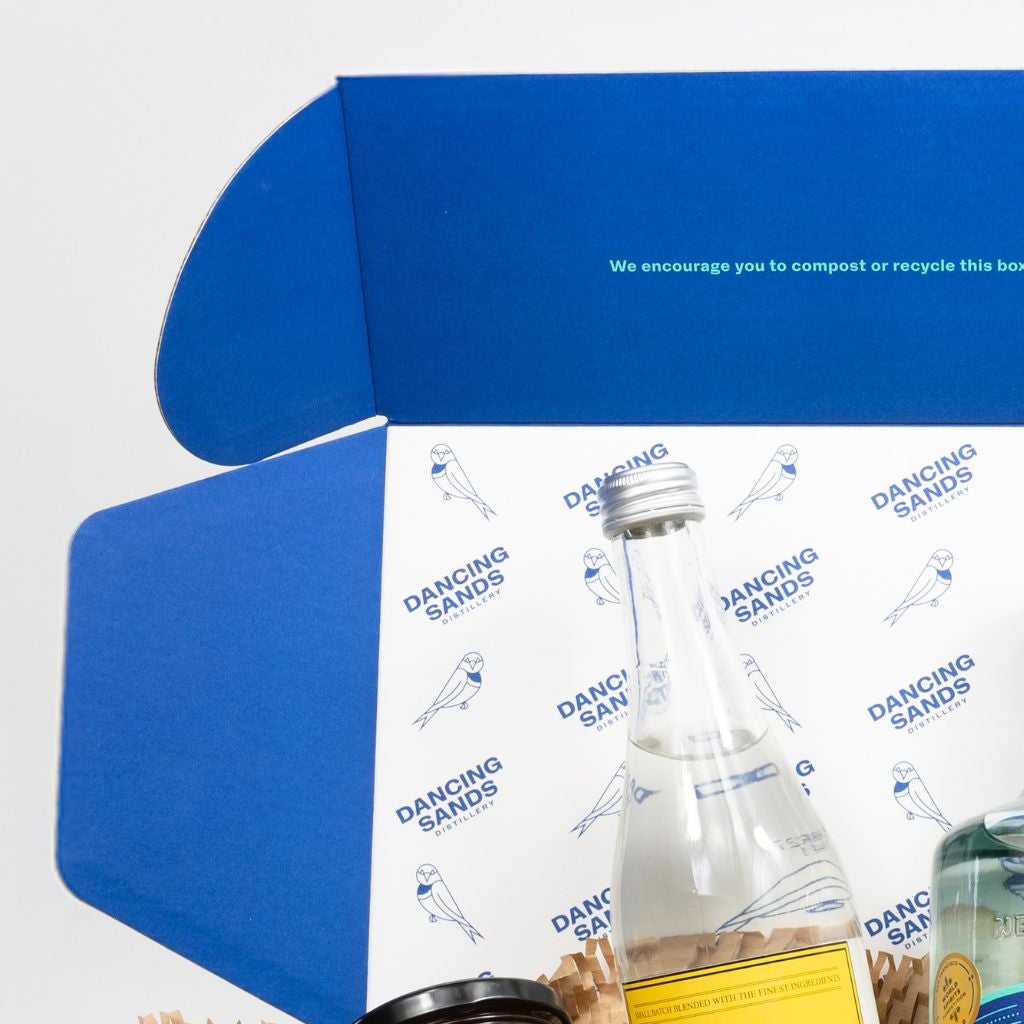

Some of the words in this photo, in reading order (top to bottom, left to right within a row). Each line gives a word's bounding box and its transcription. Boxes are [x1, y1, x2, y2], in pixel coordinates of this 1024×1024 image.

[610, 259, 636, 272] We
[641, 261, 730, 275] encourage
[735, 261, 765, 275] you
[769, 259, 787, 272] to
[791, 259, 866, 275] compost
[871, 261, 888, 272] or
[893, 258, 955, 275] recycle
[959, 258, 992, 272] this
[563, 443, 669, 510] DAING
[870, 443, 977, 511] DANCING
[893, 466, 973, 519] SANDS
[403, 546, 510, 613] DANCING
[425, 569, 505, 621] SANDS
[734, 570, 814, 623] SANDS
[579, 690, 629, 728] SAN
[867, 653, 975, 722] DANCING
[890, 677, 971, 730] SANDS
[907, 697, 967, 735] DISTILLERY
[395, 756, 503, 825] DANCING
[418, 779, 498, 832] SANDS
[434, 799, 495, 837] DISTILLERY
[551, 887, 611, 934] DANC
[864, 890, 931, 938] DANC
[673, 998, 711, 1014] BLENDED
[712, 993, 737, 1006] WITH
[737, 989, 758, 1001] THE
[758, 983, 789, 996] FINEST
[790, 974, 841, 990] INGREDIENTS
